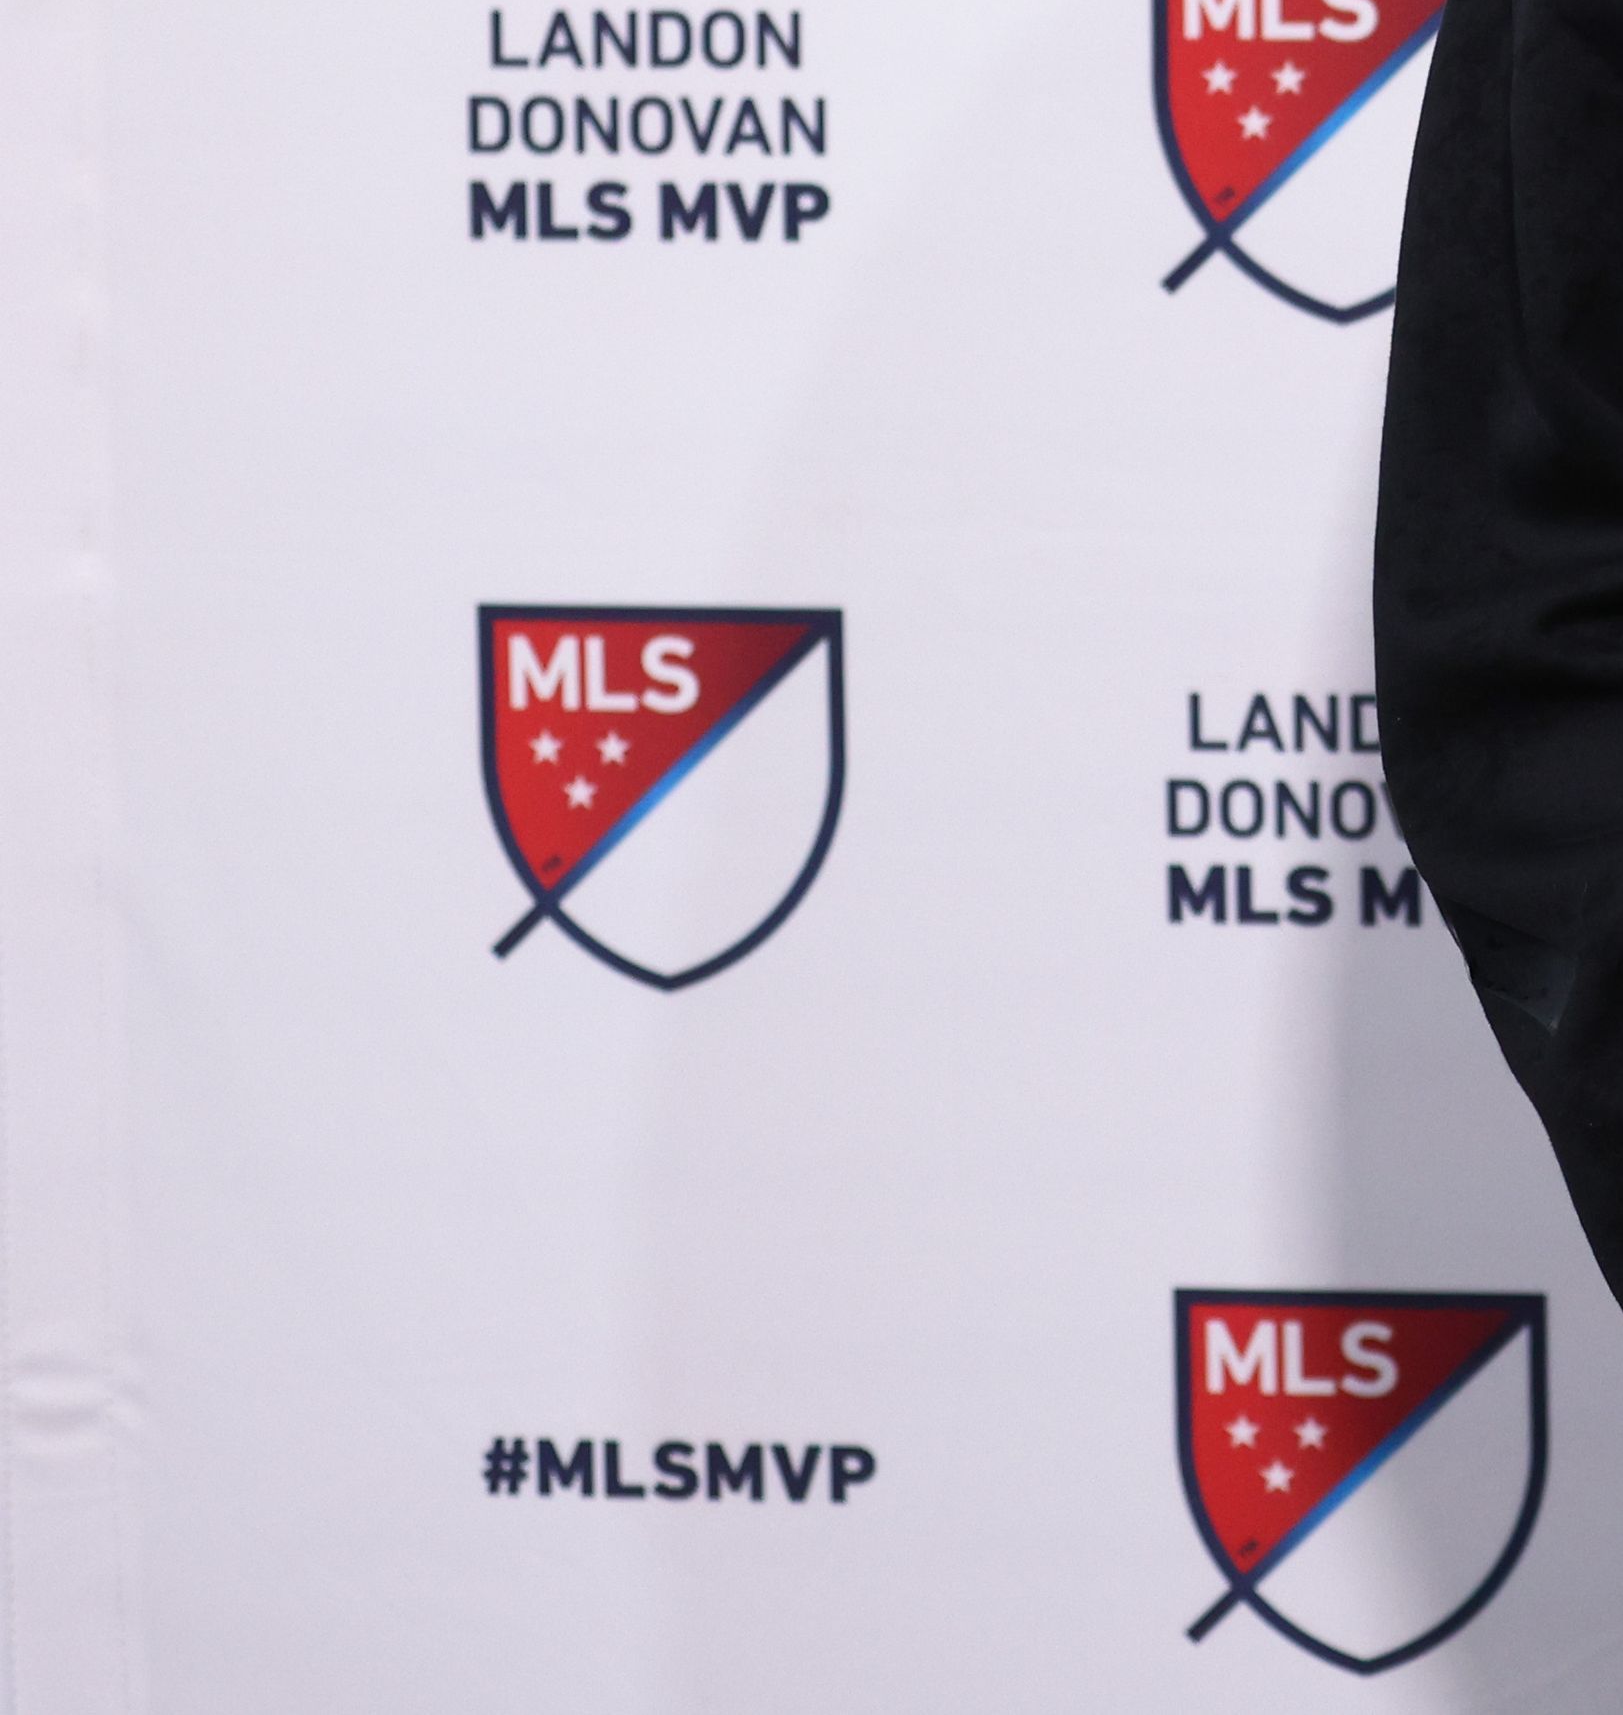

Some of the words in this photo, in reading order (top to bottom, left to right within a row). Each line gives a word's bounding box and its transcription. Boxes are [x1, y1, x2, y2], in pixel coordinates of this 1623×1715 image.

[490, 9, 802, 70] LANDON
[468, 94, 827, 156] DONOVAN
[469, 179, 634, 242] MLS
[658, 180, 831, 243] MVP
[508, 634, 700, 714] MLS
[1189, 692, 1381, 754] LAND
[1166, 779, 1402, 841] DONO
[1167, 863, 1334, 927] MLS
[1204, 1319, 1399, 1398] MLS
[482, 1436, 877, 1504] #MLSMVP
